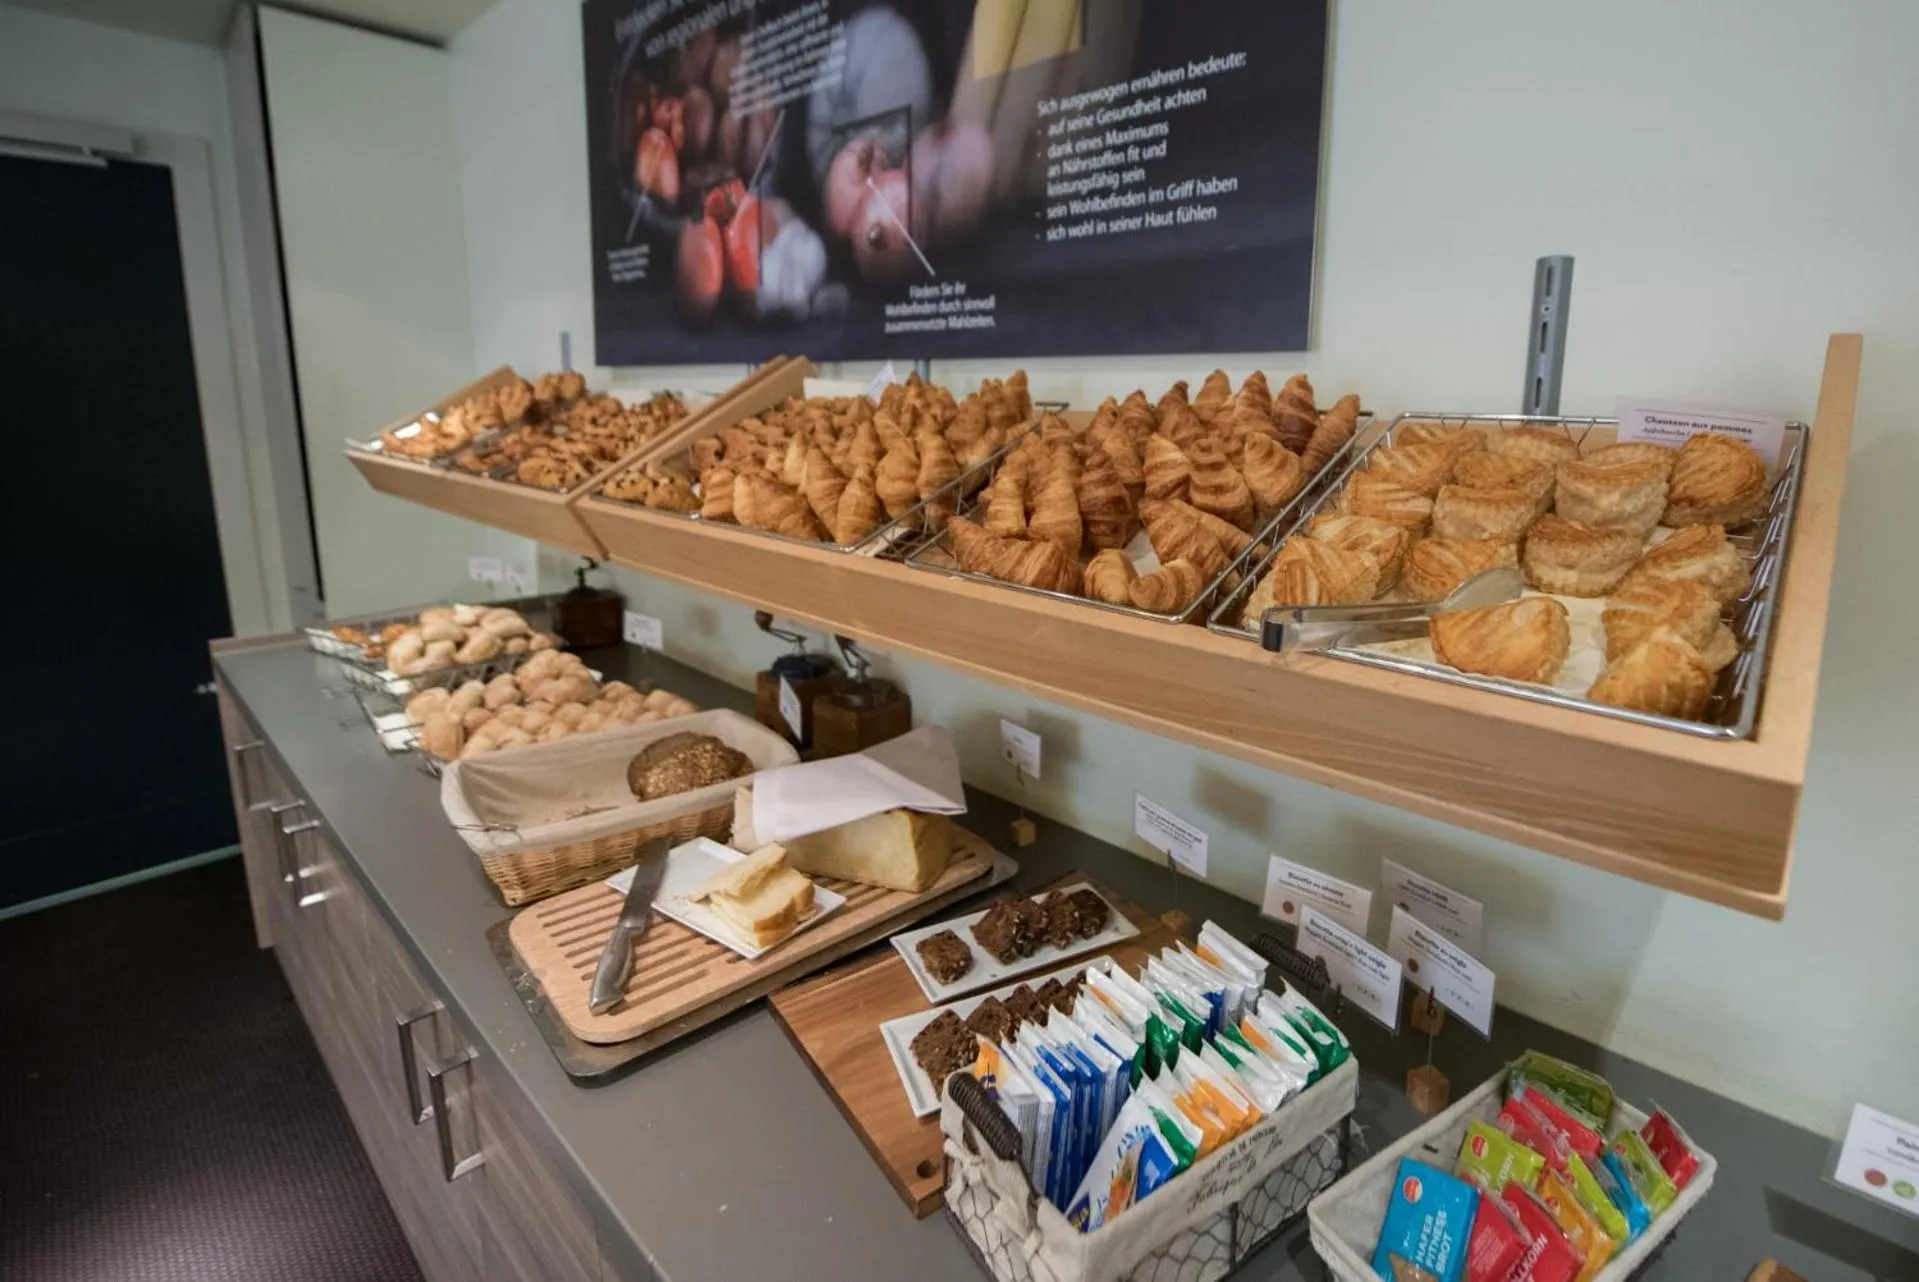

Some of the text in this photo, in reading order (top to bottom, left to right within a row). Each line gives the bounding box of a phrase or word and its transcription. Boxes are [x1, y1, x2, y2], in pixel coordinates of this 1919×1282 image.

[1037, 99, 1057, 117] Sich
[1060, 81, 1128, 111] ausgewogen
[1131, 65, 1185, 94] ernähren
[1048, 86, 1207, 136] auf seine Gesundheit achten
[1048, 121, 1169, 159] dank eines Maximums
[1048, 139, 1167, 177] an Nährstoffen fit und
[1047, 166, 1145, 197] leistungsfähig sein
[1047, 176, 1238, 219] sein Wohlbefinden im Griff haben
[1047, 204, 1217, 241] sich wohl in seiner Haut fühlen
[1415, 1213, 1434, 1263] HAFER
[1424, 1210, 1448, 1270] FITNESS
[1434, 1230, 1452, 1274] BROT
